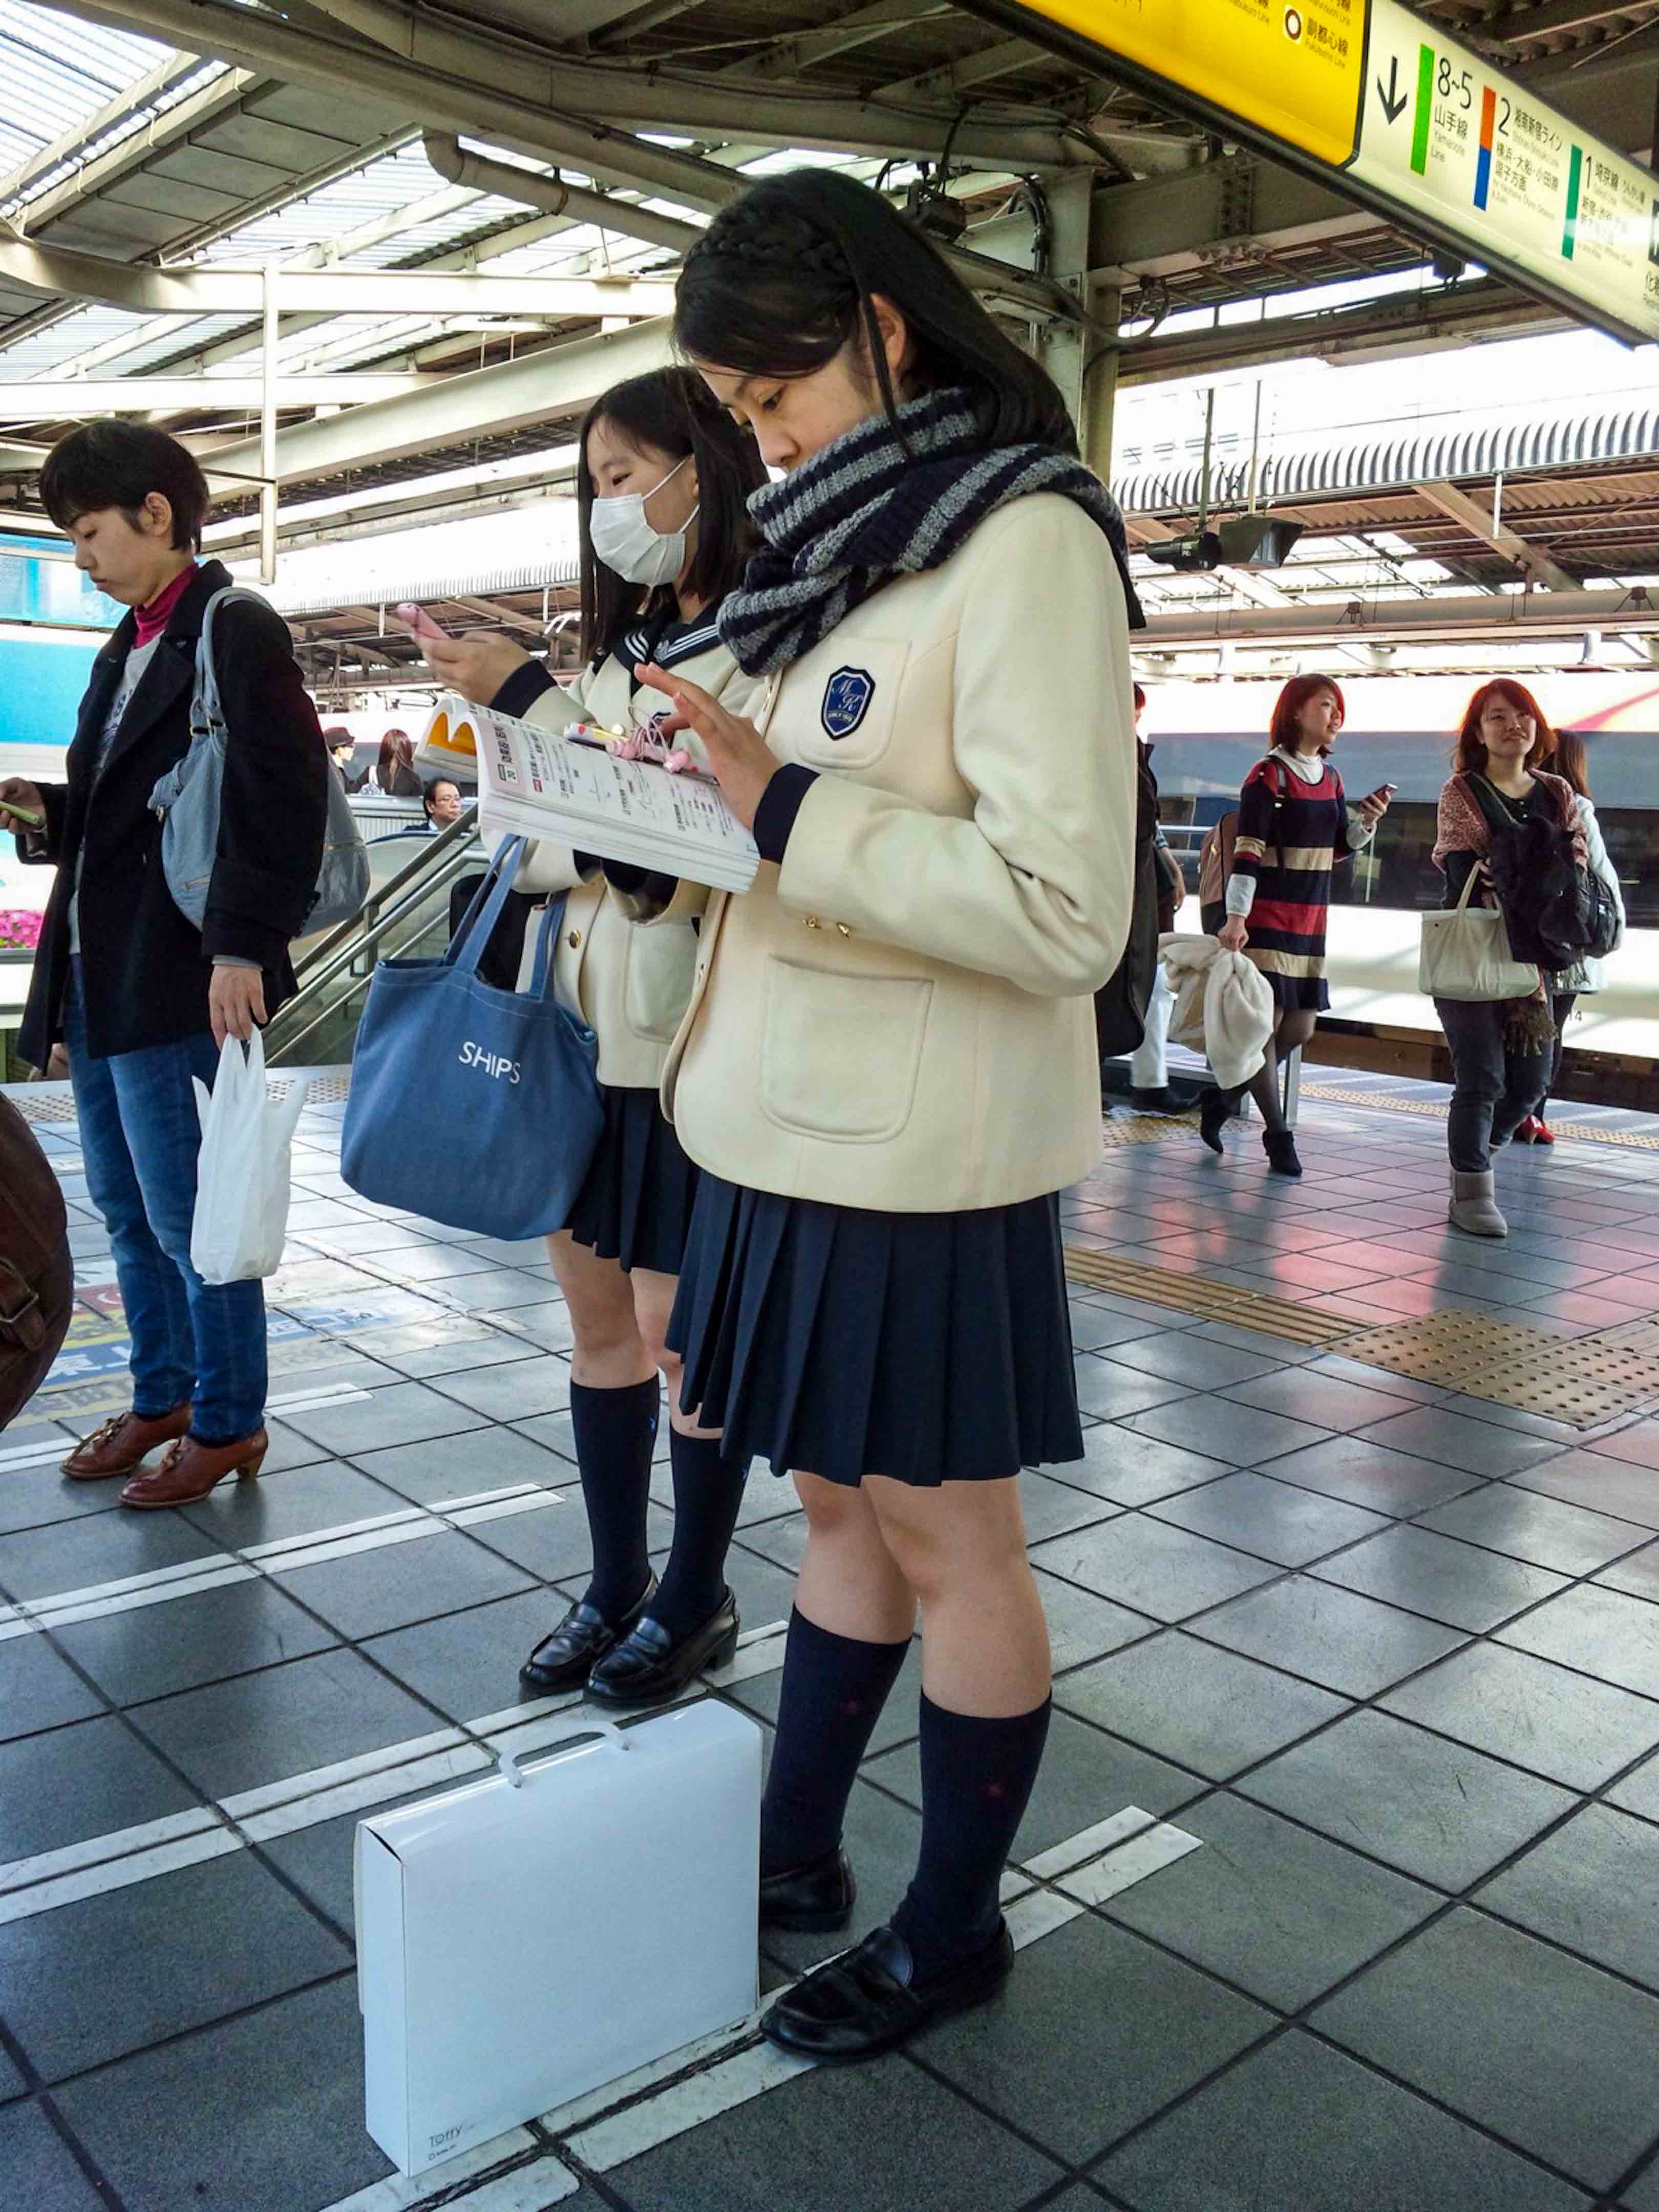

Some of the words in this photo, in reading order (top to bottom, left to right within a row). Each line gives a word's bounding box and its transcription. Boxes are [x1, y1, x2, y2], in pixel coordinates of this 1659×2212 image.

[1434, 104, 1468, 140] 山手線
[1498, 97, 1511, 137] 2
[1585, 156, 1592, 189] 1
[458, 1040, 521, 1084] SHIPS
